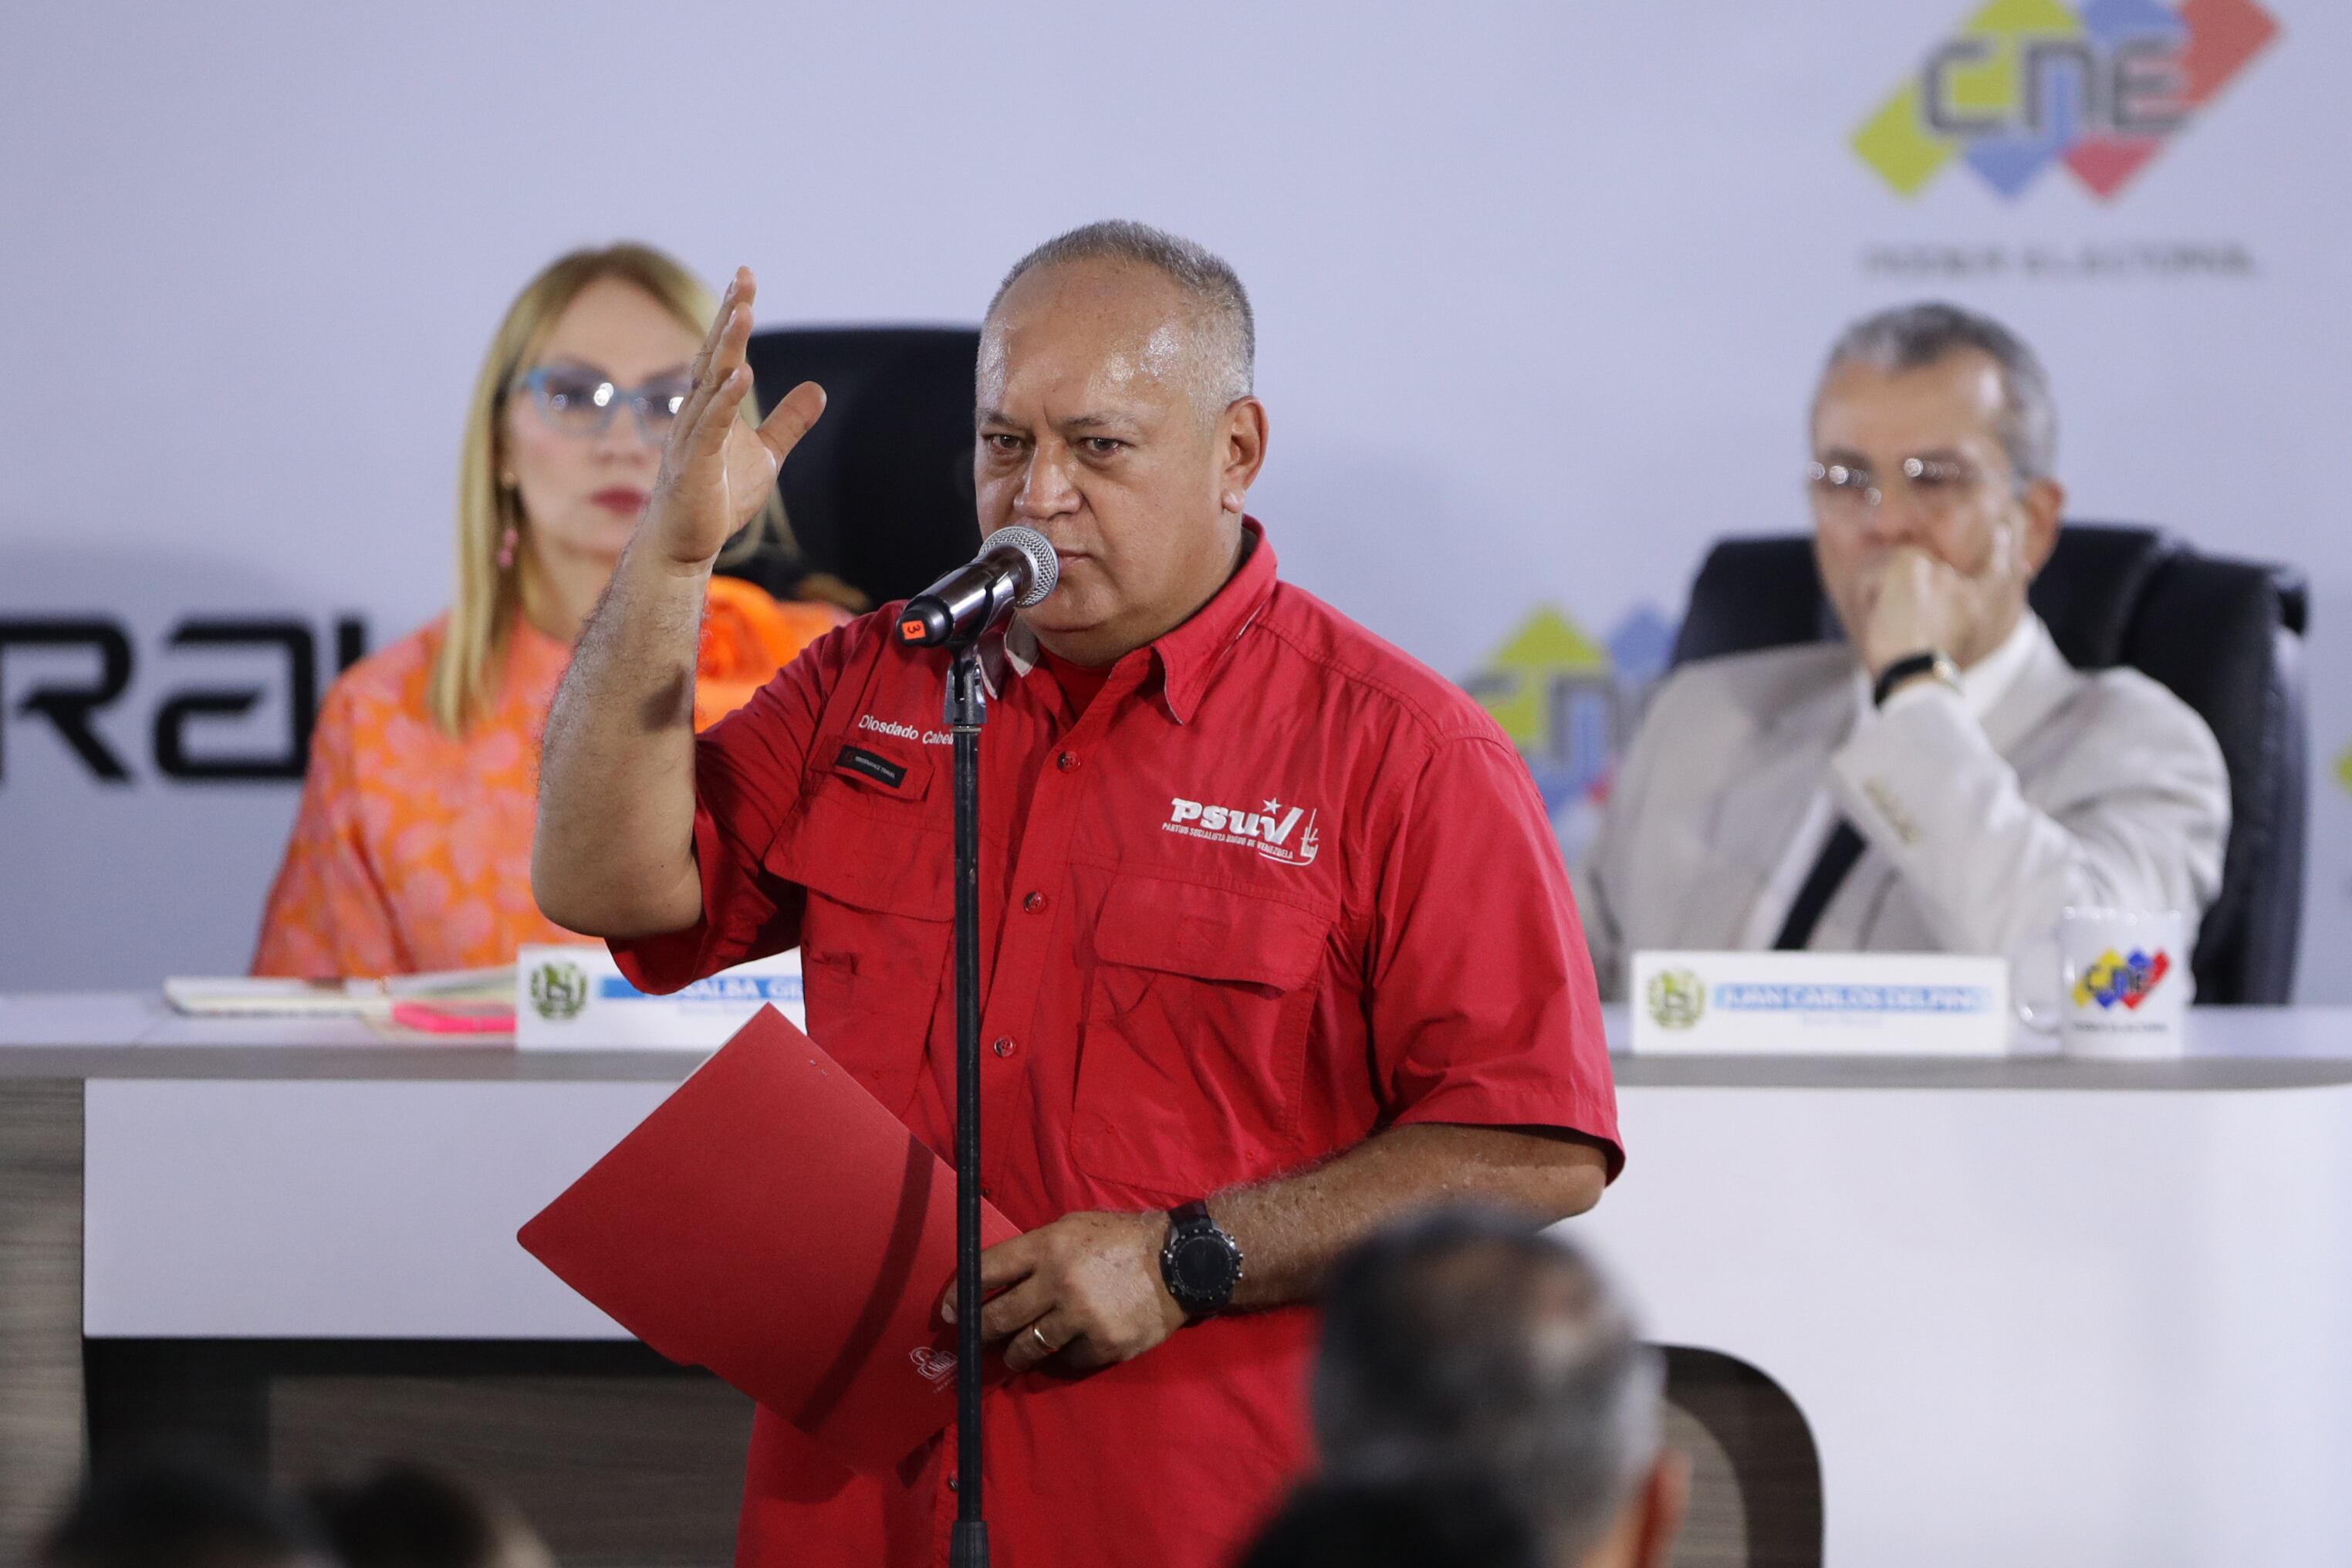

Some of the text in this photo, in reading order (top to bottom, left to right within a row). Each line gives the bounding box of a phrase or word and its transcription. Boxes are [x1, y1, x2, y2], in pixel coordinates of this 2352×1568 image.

[858, 715, 919, 740] Diosdado
[1162, 823, 1189, 836] PARTIDO
[1189, 827, 1226, 842] SOCIALISTA
[1247, 839, 1256, 847] DE
[1256, 842, 1294, 860] VENEZUELA
